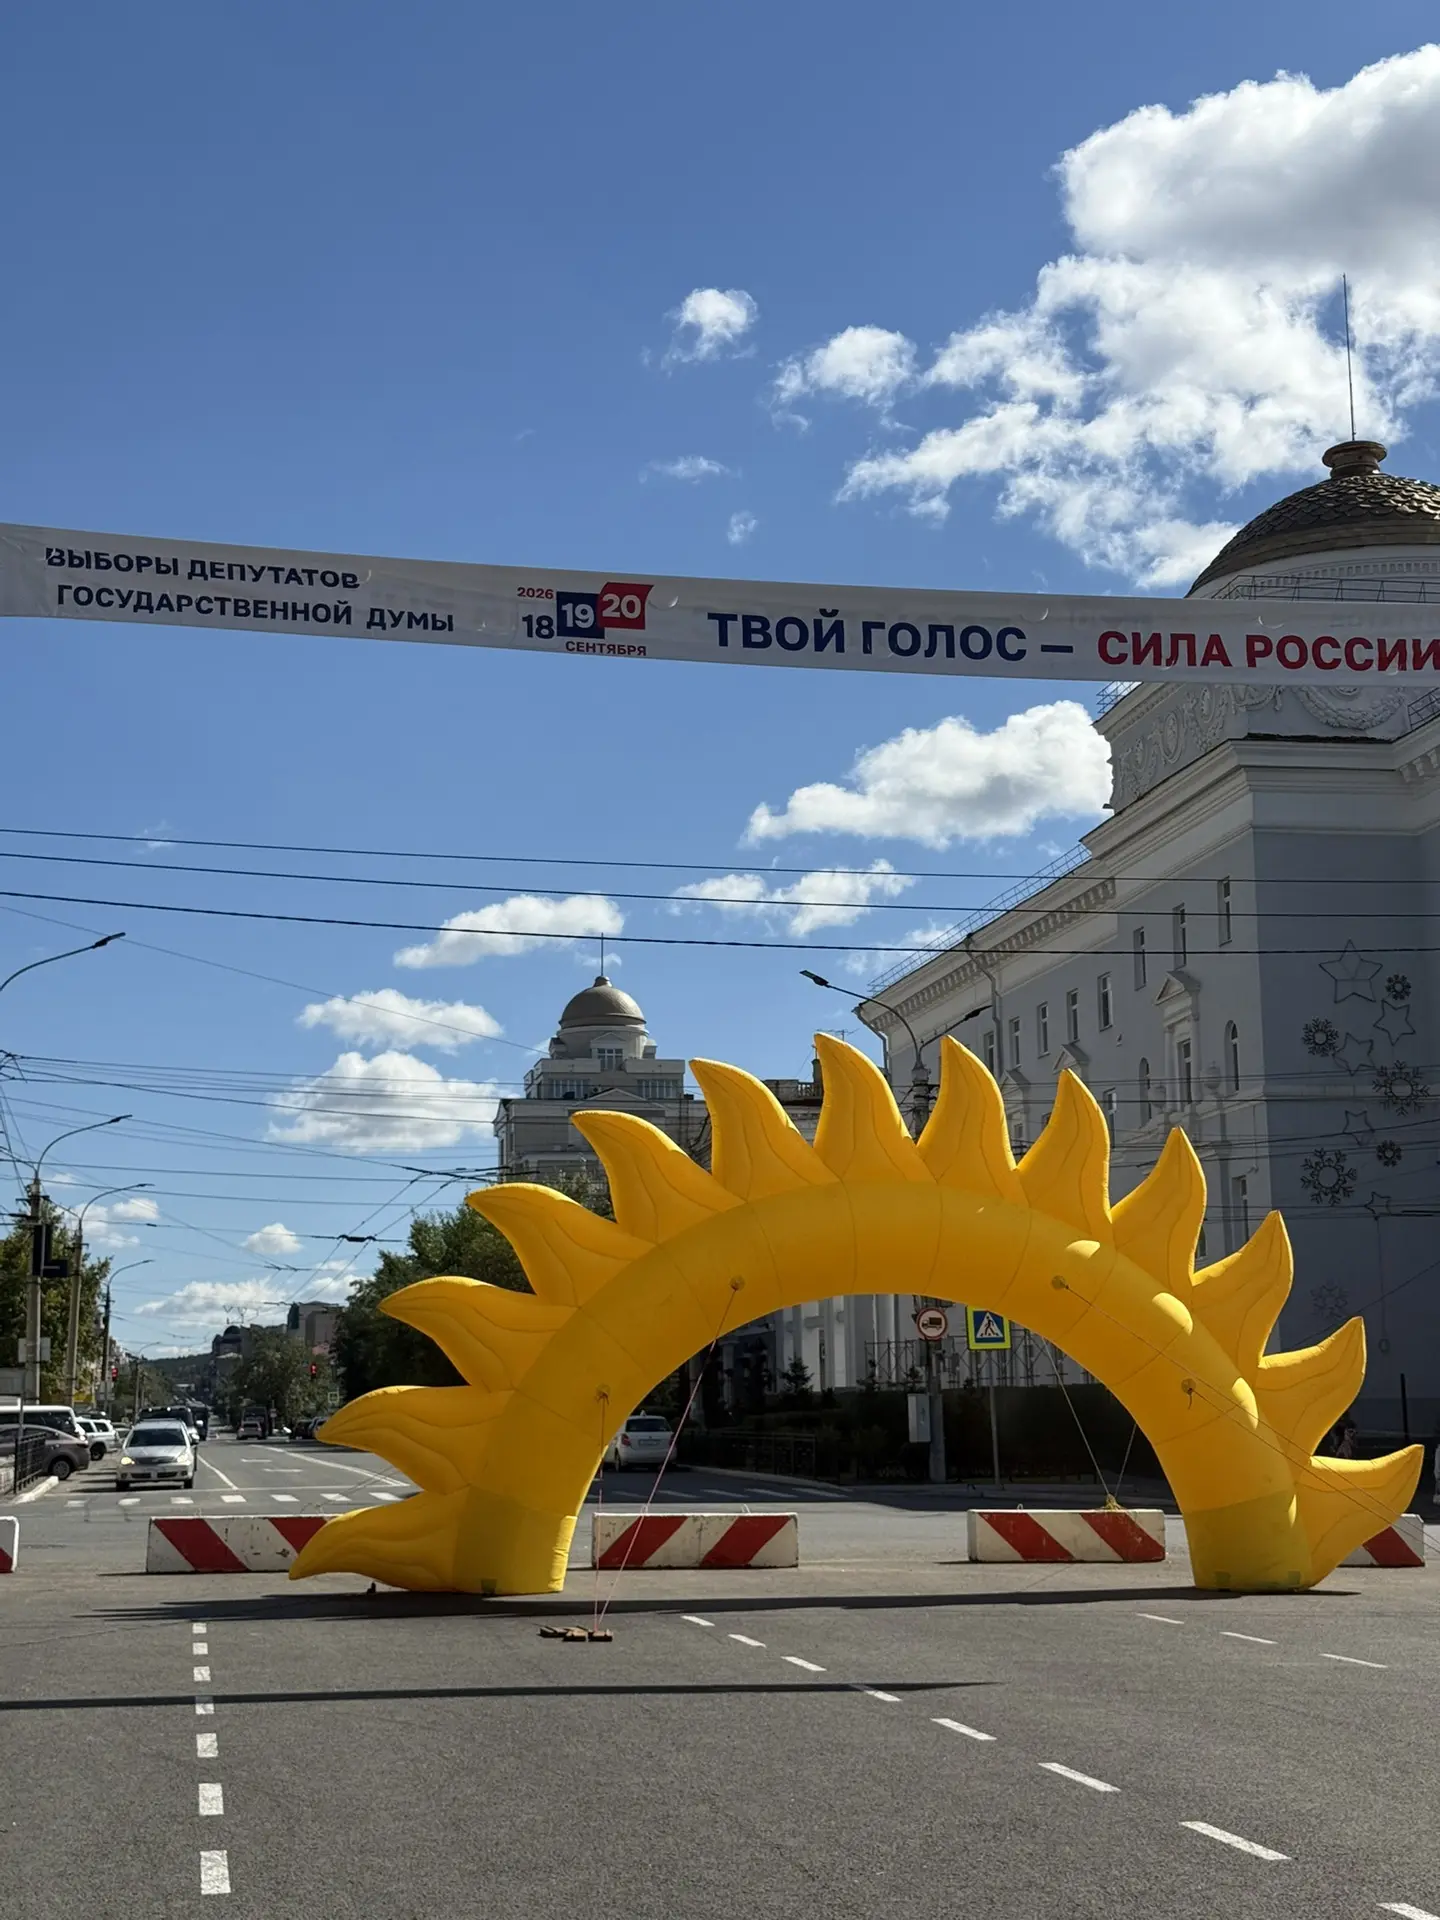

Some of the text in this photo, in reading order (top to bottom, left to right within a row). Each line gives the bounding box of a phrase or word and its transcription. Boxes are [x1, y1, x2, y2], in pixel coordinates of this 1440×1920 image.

[46, 547, 360, 589] ВЫБОРЫ ДЕПУТАТОВ
[57, 584, 454, 632] ГОСУДАРСТВЕННОЙ ДУМЫ
[517, 586, 554, 600] 2026
[522, 593, 641, 639] 18 19 20
[565, 641, 647, 656] СЕНТЯБРЯ
[707, 608, 846, 654] ТВОЙ
[862, 620, 1028, 662] ГОЛОС
[1097, 630, 1233, 668] СИЛА
[1245, 633, 1440, 672] РОССИИ
